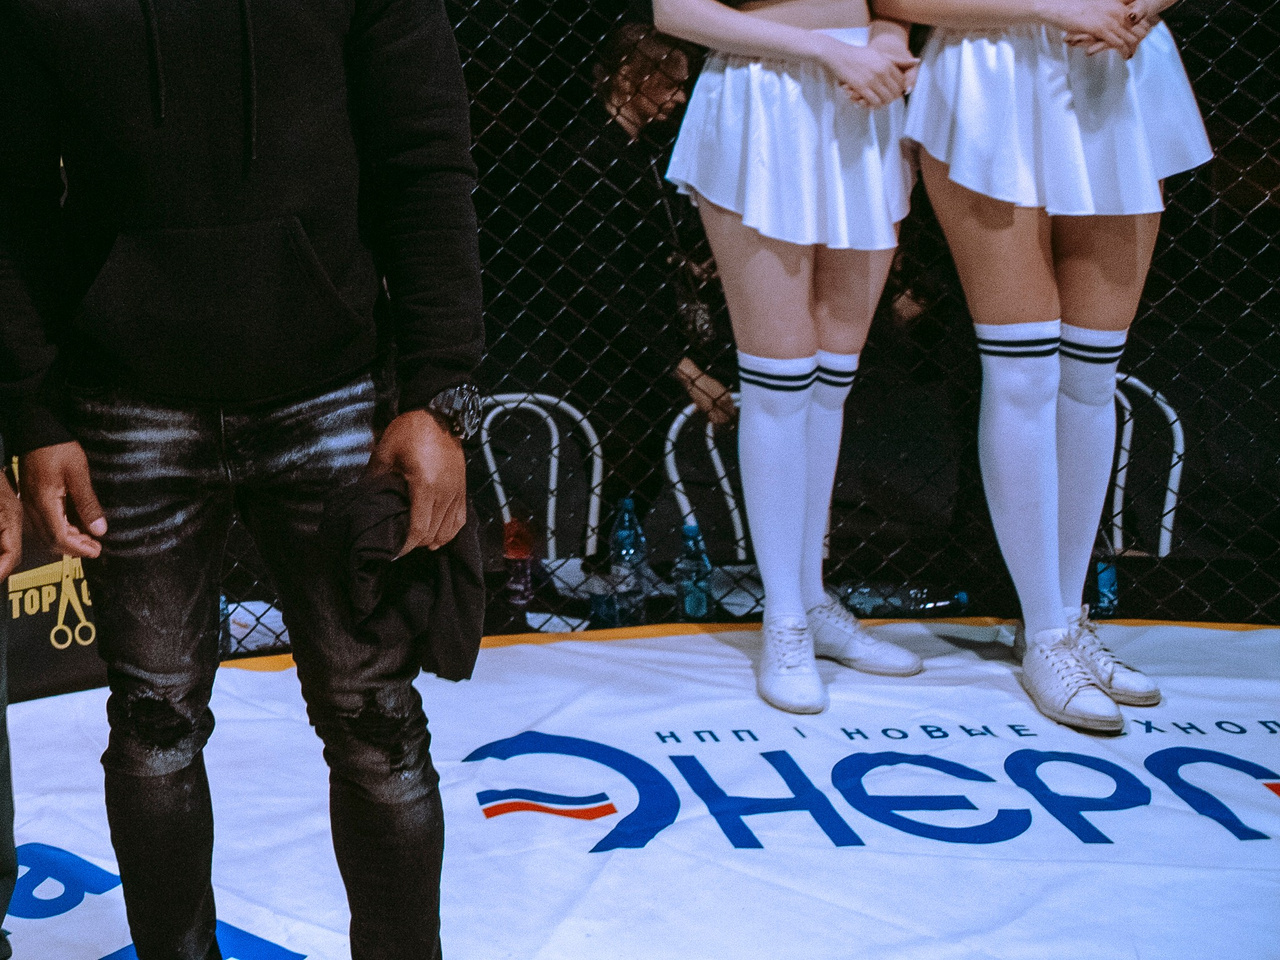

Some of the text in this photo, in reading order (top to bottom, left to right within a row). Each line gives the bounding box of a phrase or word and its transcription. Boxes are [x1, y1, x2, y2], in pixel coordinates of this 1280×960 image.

[9, 585, 57, 619] TOP
[655, 728, 760, 744] НПП
[840, 724, 1038, 740] НОВЫЕ
